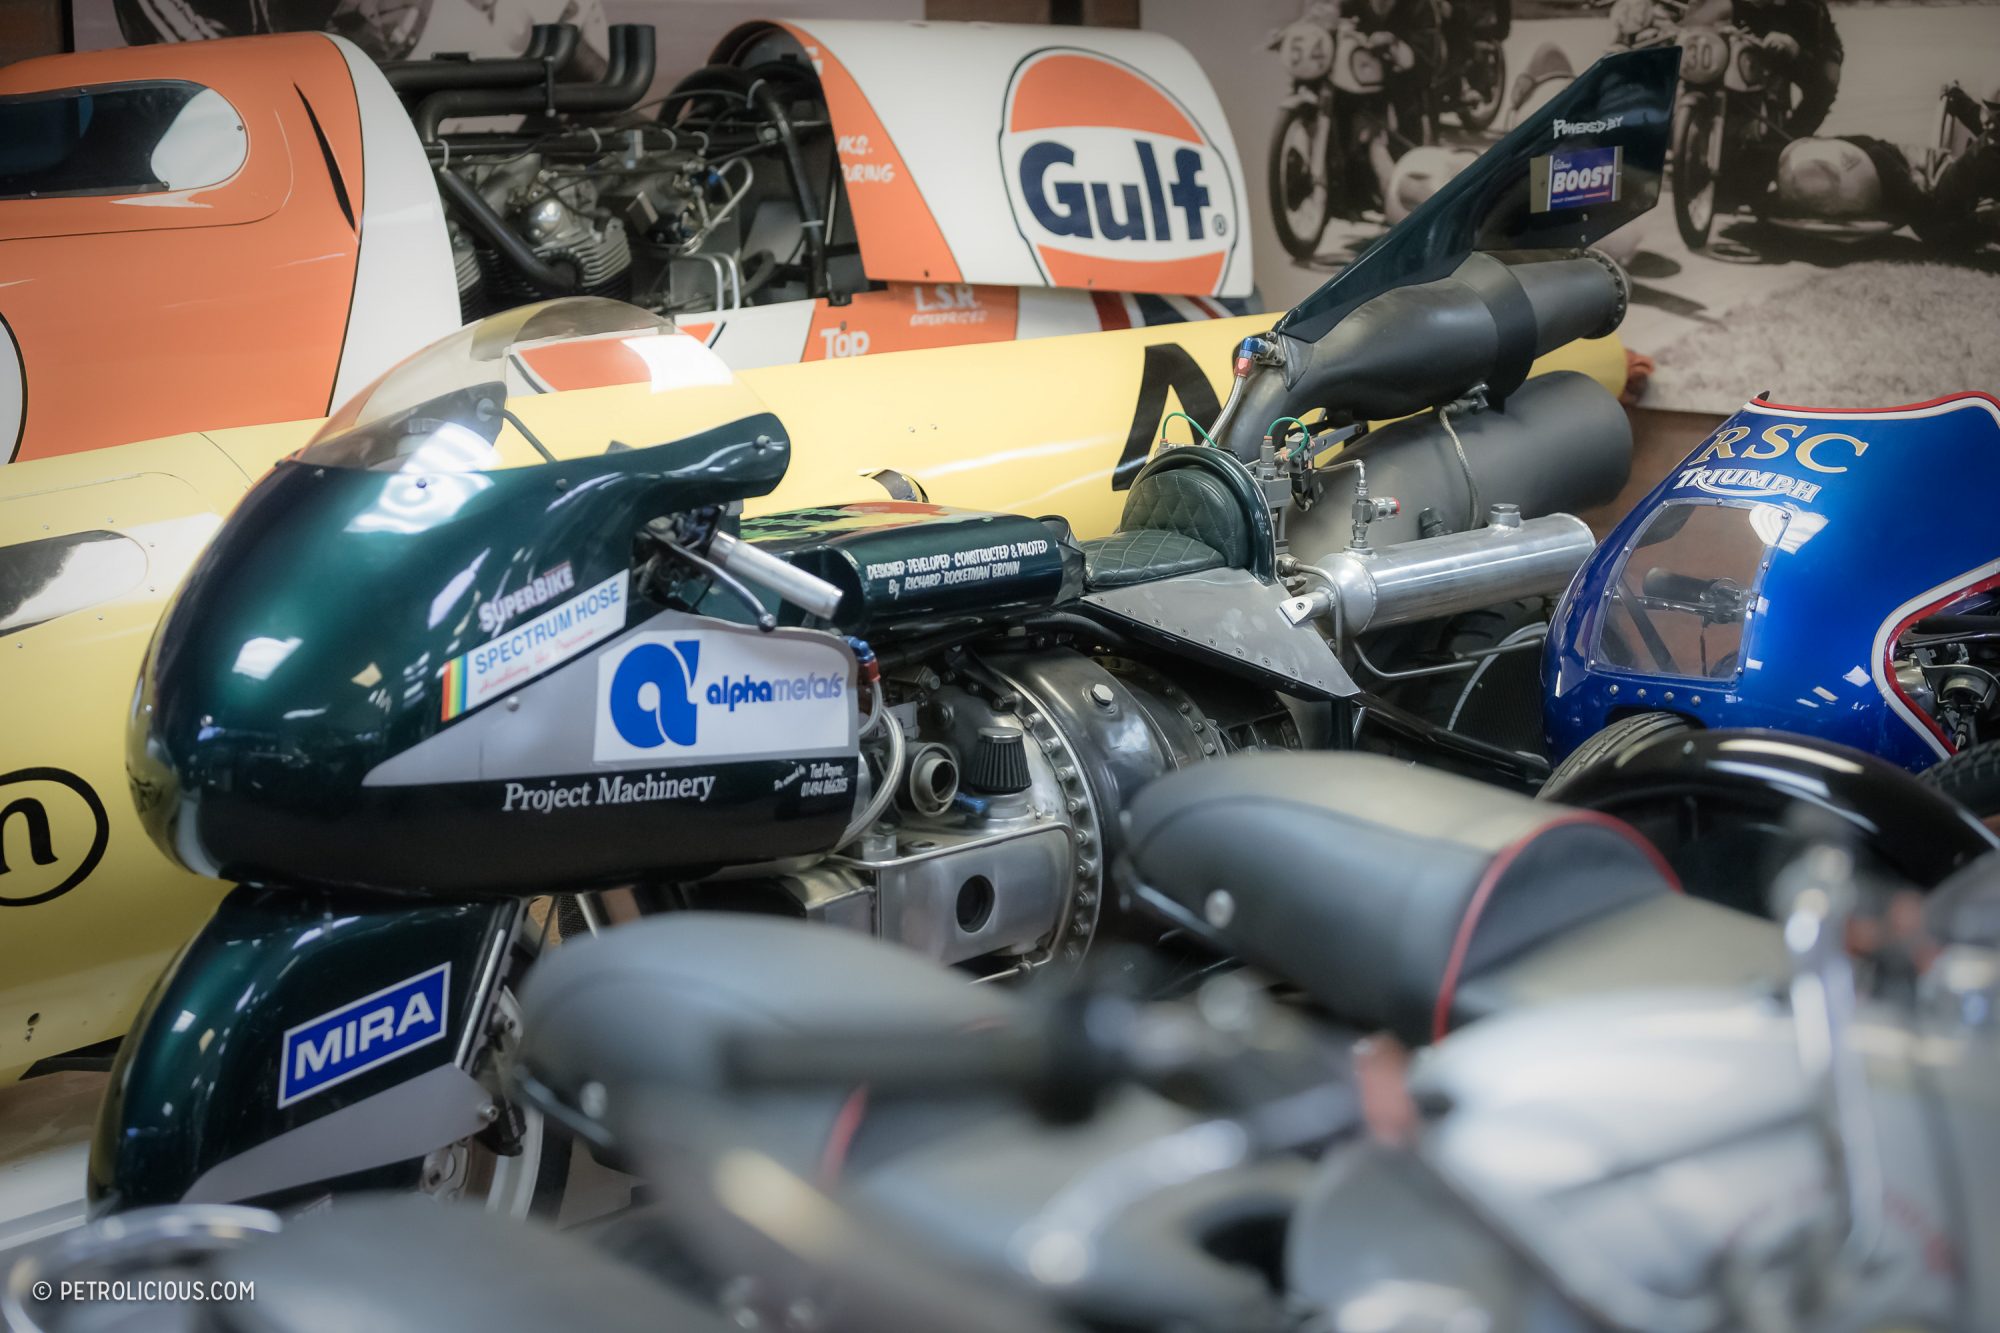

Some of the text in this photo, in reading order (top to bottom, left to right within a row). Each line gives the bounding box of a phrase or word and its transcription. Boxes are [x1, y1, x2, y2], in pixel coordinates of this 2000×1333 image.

[1553, 118, 1606, 139] POWERED
[1019, 138, 1210, 240] Gulf
[1552, 166, 1613, 193] BOOST
[1688, 423, 1869, 473] RSC
[1673, 465, 1822, 503] TRIUMPH
[1010, 544, 1018, 559] &
[1017, 540, 1048, 556] PILOTED
[904, 573, 941, 591] RICHARD
[992, 561, 1020, 578] BROWN
[478, 565, 575, 633] SUPERBIKE
[475, 608, 572, 675] SPECTRUM
[575, 582, 621, 624] HOSE
[810, 762, 824, 779] Ted
[502, 771, 715, 814] Project Machinery
[295, 991, 435, 1081] MIRA
